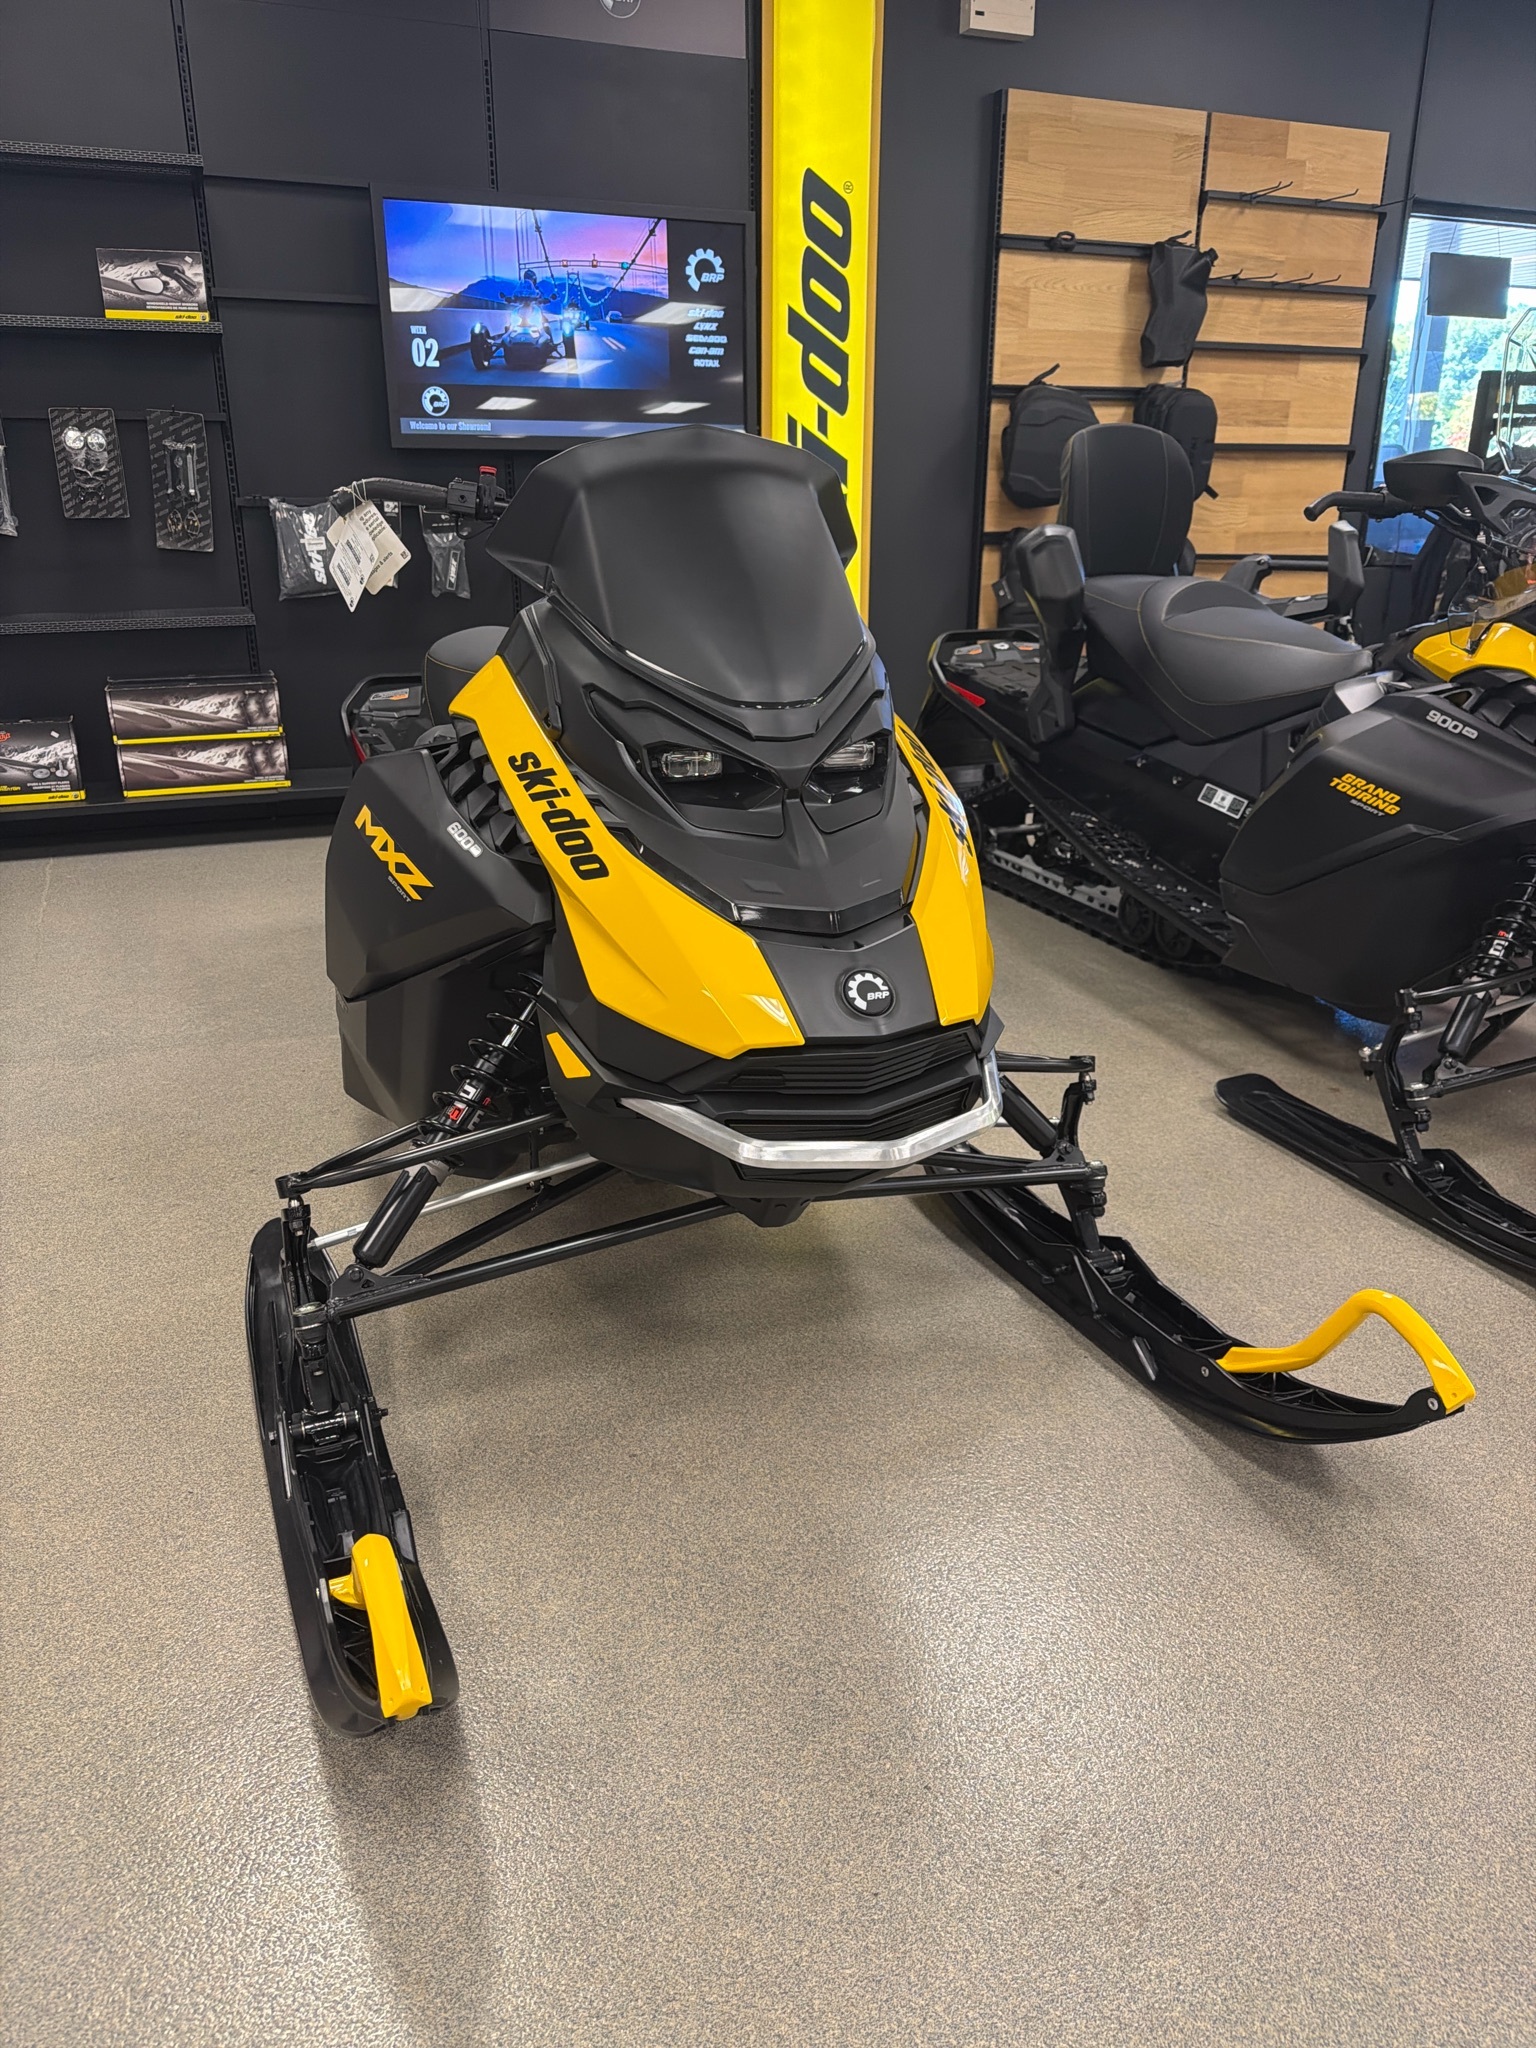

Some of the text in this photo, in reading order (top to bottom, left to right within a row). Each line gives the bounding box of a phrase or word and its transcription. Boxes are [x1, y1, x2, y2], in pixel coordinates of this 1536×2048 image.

[701, 273, 725, 283] BRP
[688, 308, 724, 318] ski-doo
[410, 325, 427, 334] WEEK
[788, 167, 852, 505] i-doo
[412, 337, 440, 367] 02
[433, 400, 448, 408] BRP
[409, 421, 492, 431] Welcome to our Showroom!
[1425, 709, 1464, 734] 900
[1329, 777, 1401, 815] TOURING
[1340, 773, 1401, 804] GRAND
[508, 751, 610, 881] ski-doo
[1349, 798, 1386, 817] SPORT
[446, 821, 475, 850] 600
[354, 804, 434, 901] MXZ
[387, 875, 412, 902] SPORT
[867, 990, 890, 1001] BRP
